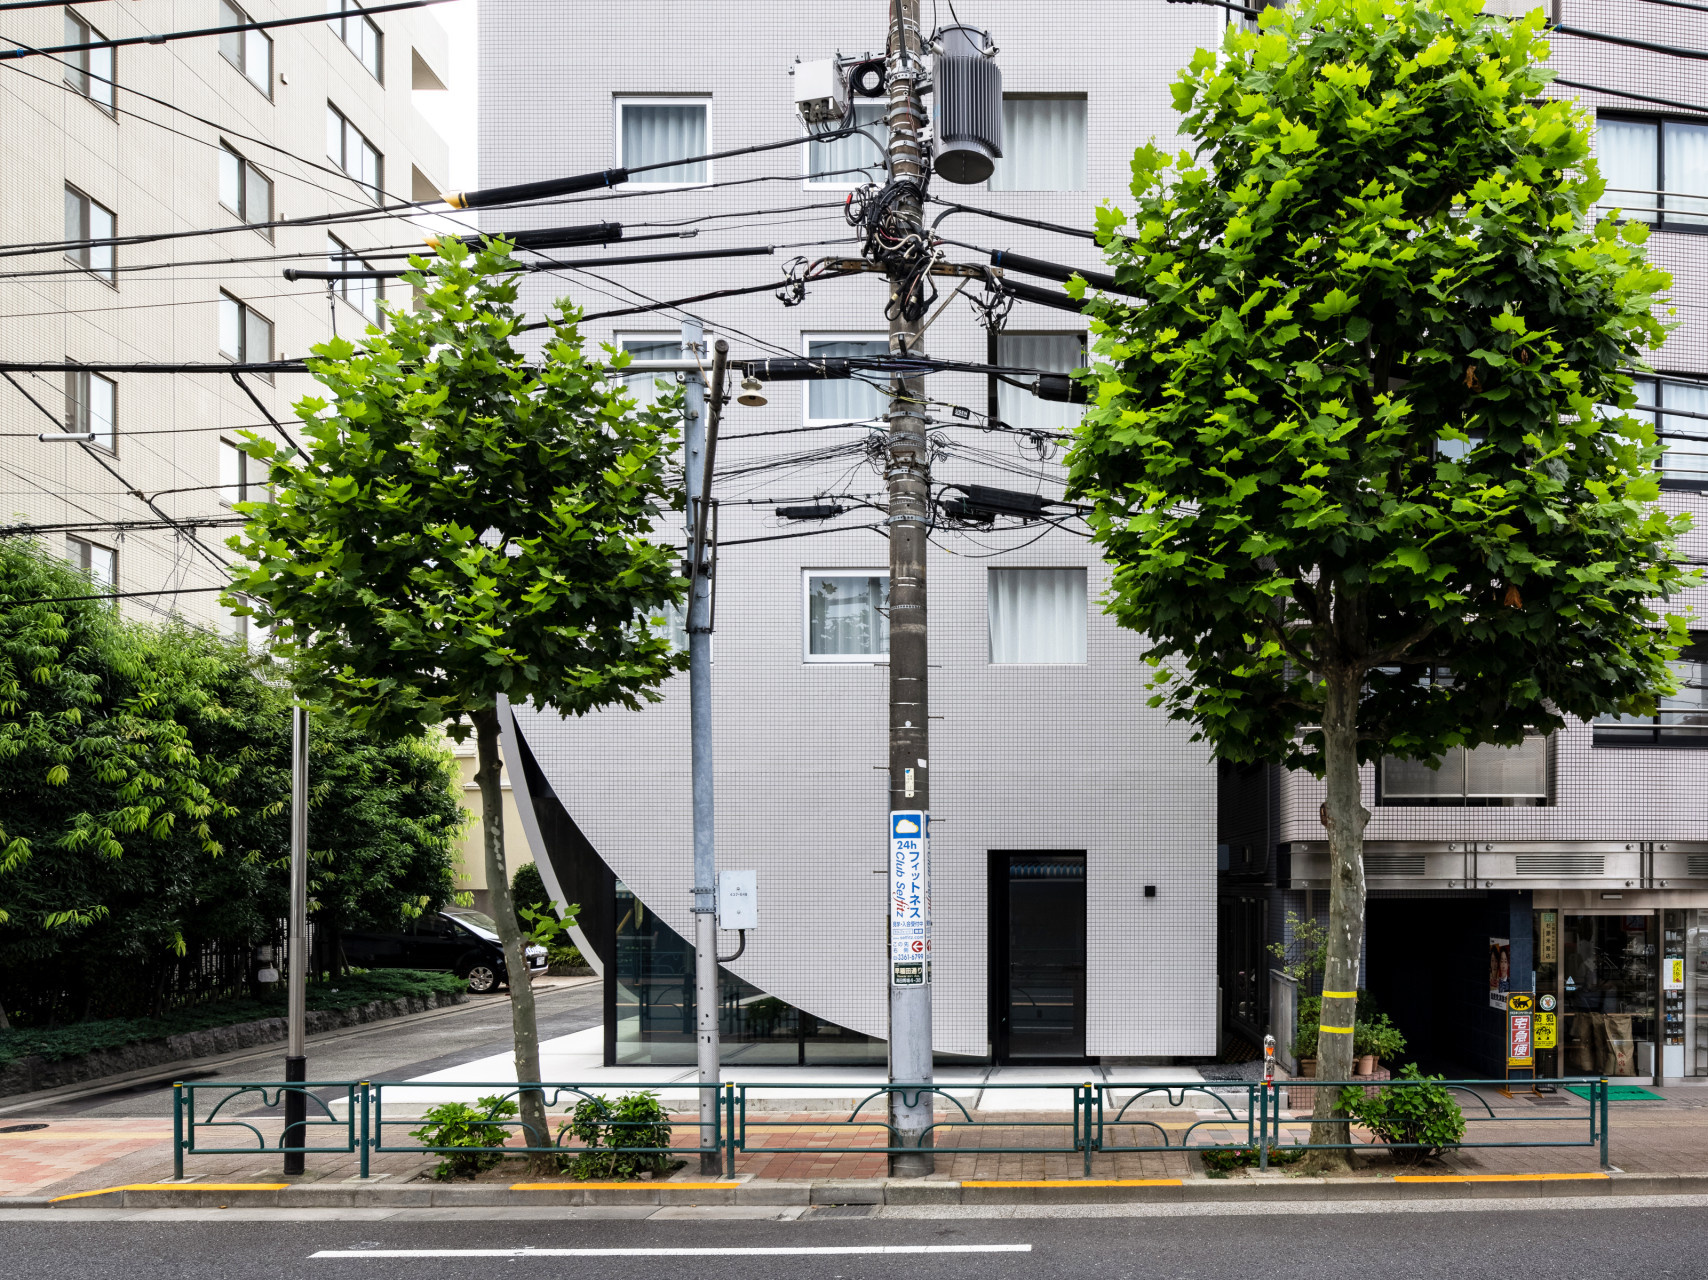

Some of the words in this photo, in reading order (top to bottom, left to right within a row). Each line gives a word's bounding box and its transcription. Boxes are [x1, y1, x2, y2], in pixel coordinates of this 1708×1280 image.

[897, 840, 917, 850] 24h
[896, 851, 905, 877] Club
[909, 851, 921, 918] フィットネス
[1513, 1016, 1529, 1056] 宅急便
